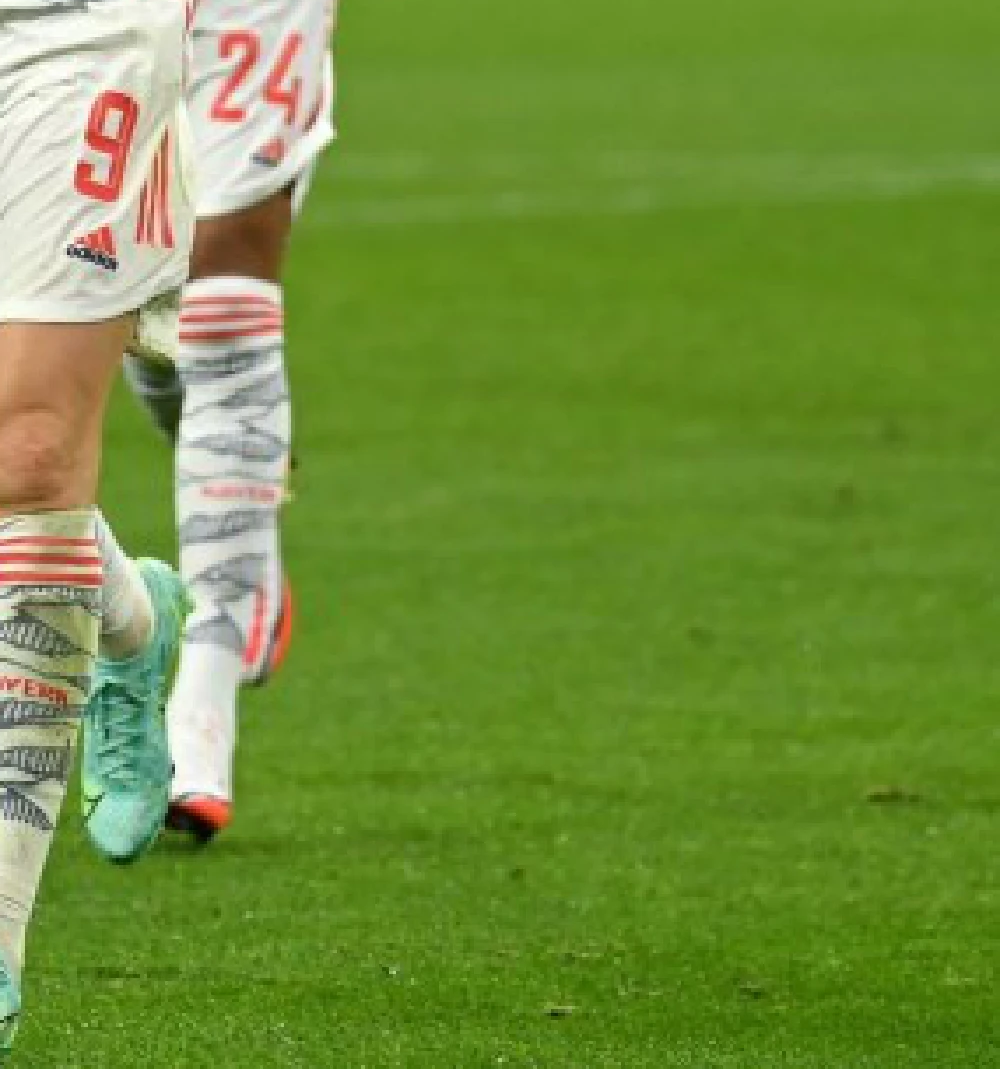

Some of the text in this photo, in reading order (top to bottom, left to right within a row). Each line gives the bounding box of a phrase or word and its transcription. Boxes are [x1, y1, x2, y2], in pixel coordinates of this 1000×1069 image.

[209, 29, 304, 125] 24
[73, 89, 140, 202] 9
[66, 243, 119, 272] adidas
